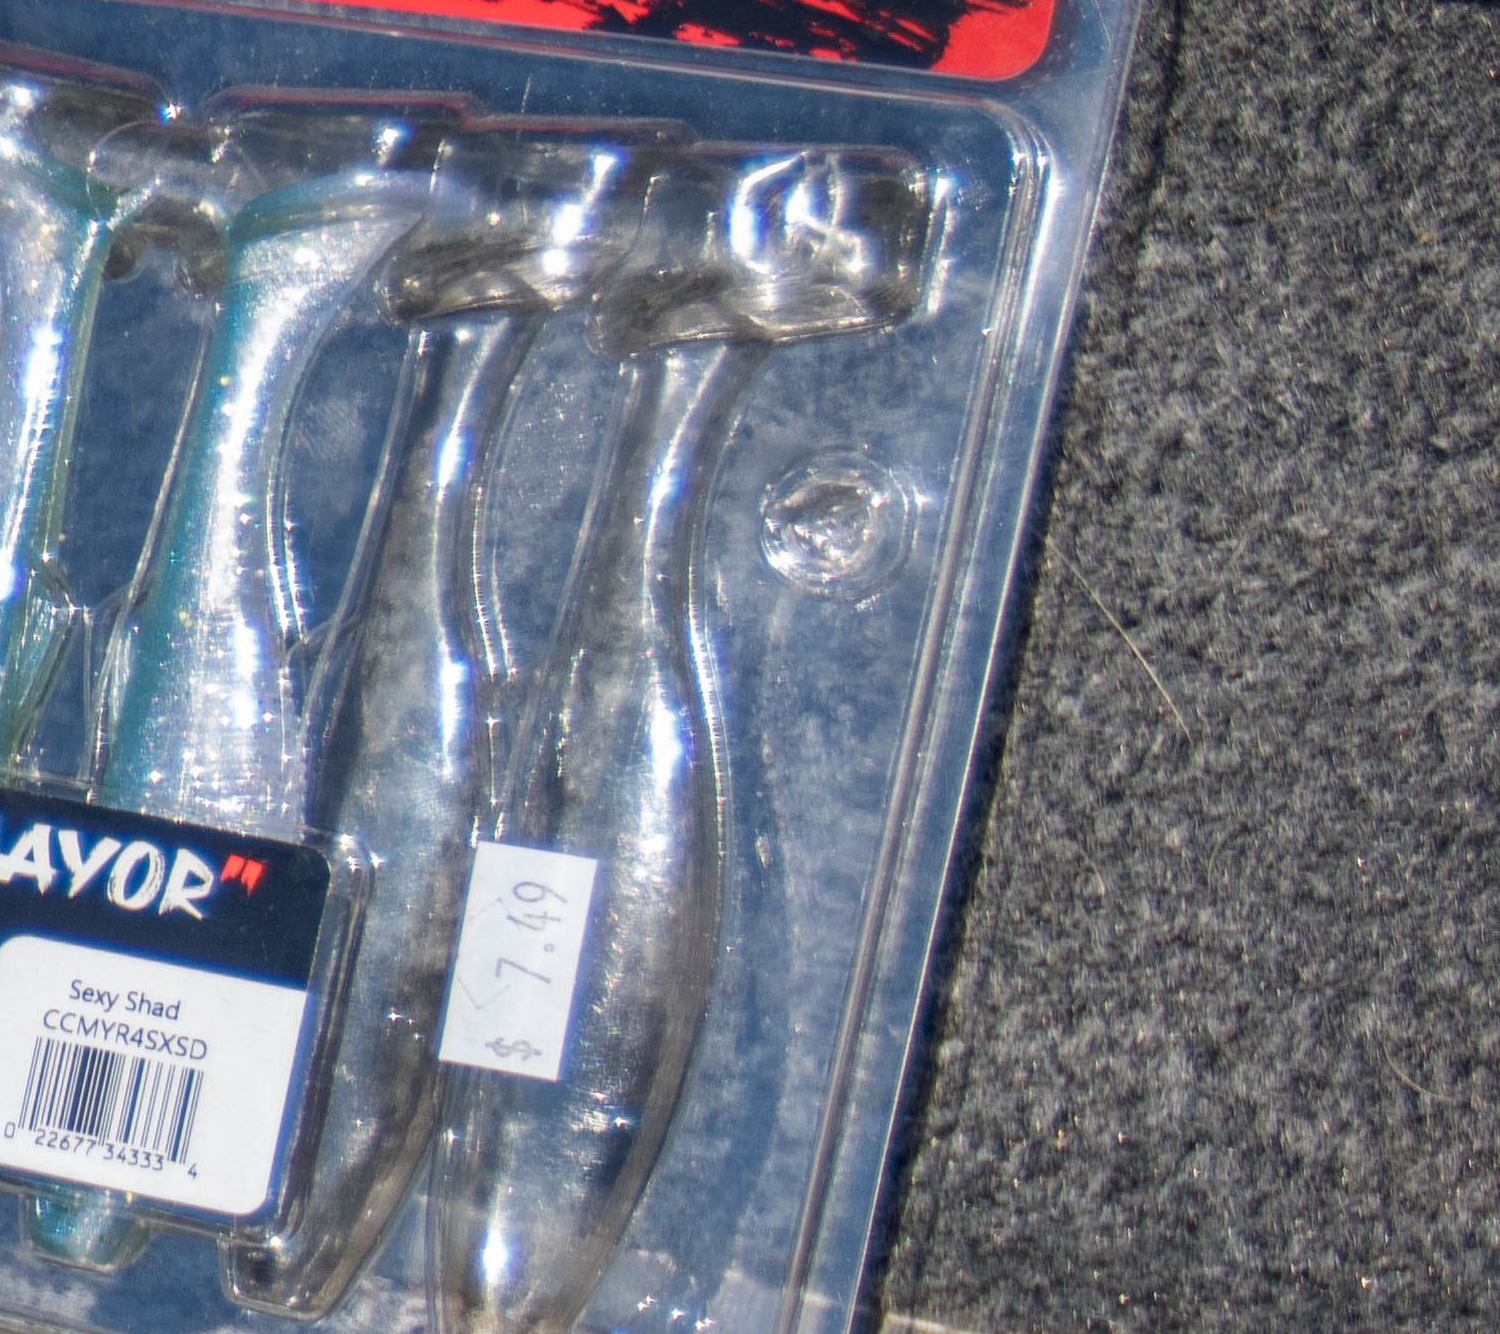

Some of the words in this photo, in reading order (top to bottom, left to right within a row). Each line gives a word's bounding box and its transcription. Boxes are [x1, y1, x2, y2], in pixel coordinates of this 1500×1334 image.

[69, 979, 120, 1013] Sexy
[124, 990, 182, 1021] Shad
[42, 1008, 208, 1061] CCMYR4SXSD
[34, 1128, 98, 1156] 22677
[102, 1142, 165, 1172] 34333
[187, 1163, 198, 1179] 4
